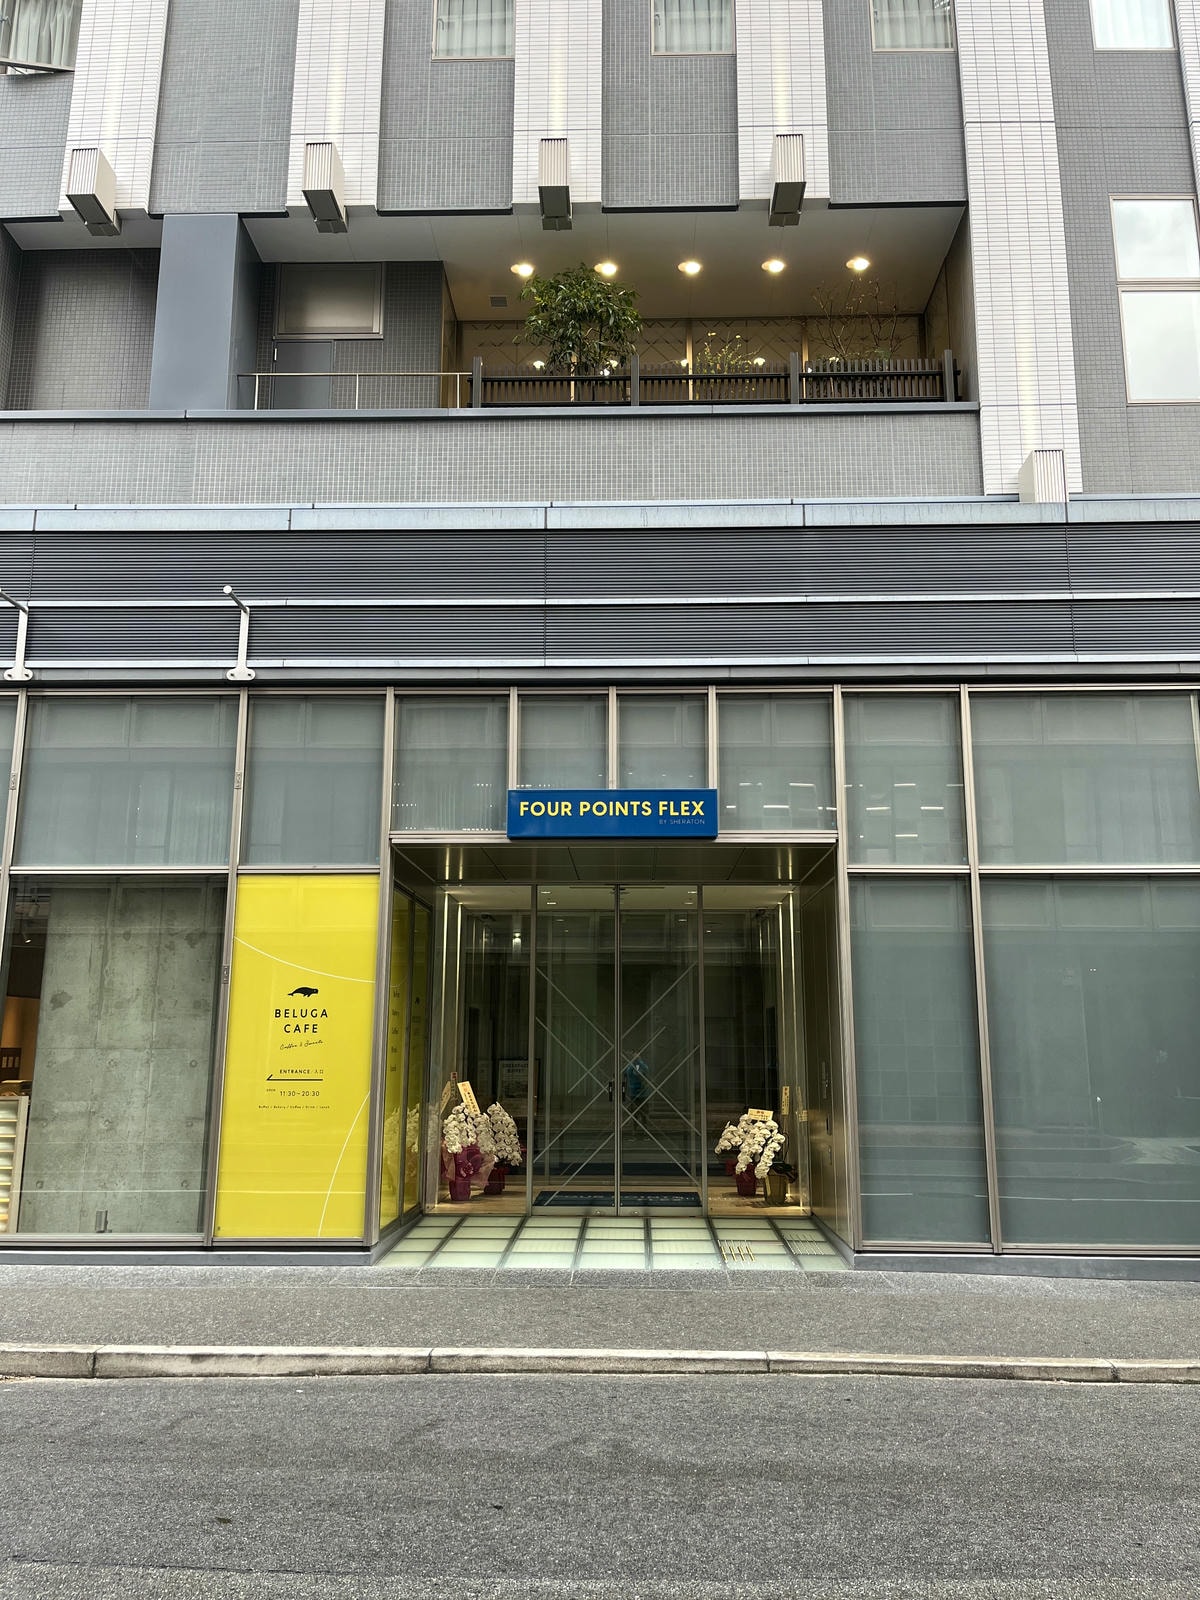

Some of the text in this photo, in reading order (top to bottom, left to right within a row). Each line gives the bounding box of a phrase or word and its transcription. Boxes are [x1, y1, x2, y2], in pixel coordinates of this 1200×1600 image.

[519, 801, 705, 816] FOUR POINTS FLEX
[274, 1008, 329, 1018] BELUGA
[283, 1023, 319, 1034] CAFE
